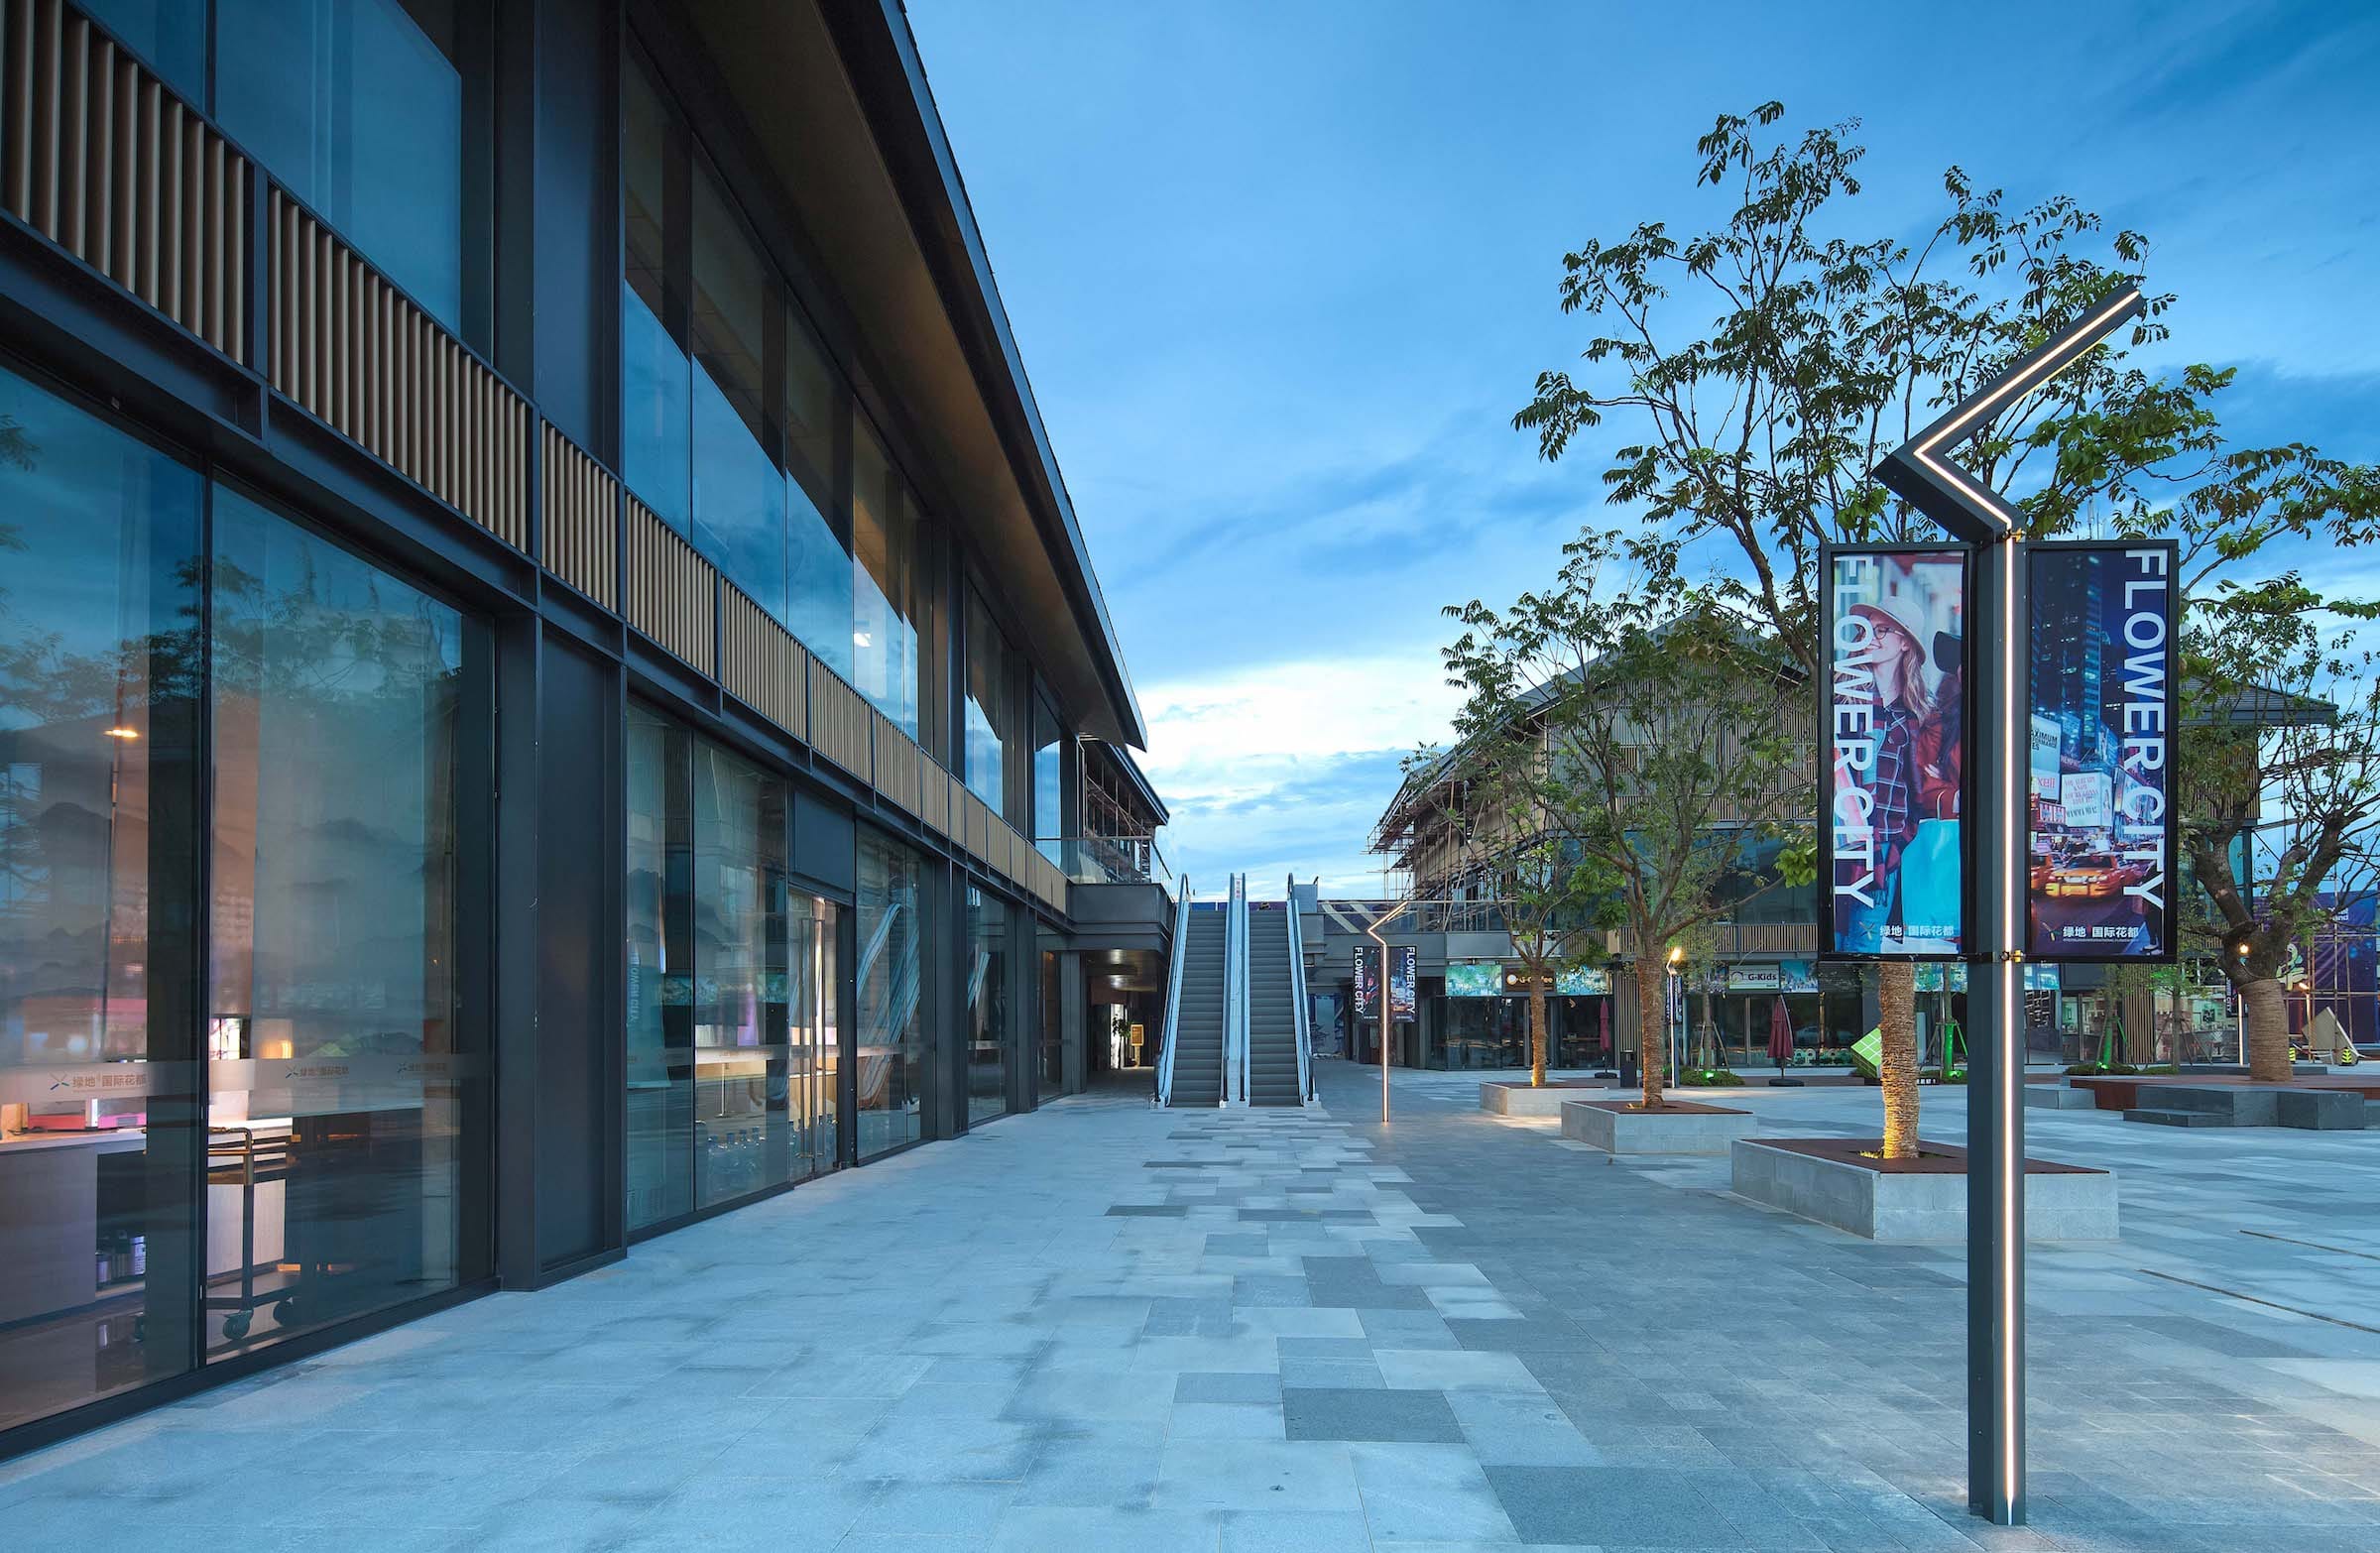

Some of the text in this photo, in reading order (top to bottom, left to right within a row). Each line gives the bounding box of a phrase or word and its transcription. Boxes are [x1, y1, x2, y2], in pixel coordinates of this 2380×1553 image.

[1834, 556, 1874, 908] FLOWER CITY
[2123, 549, 2167, 909] FLOWER CITY
[1880, 924, 1955, 937] 绿地 国际花都
[2063, 925, 2139, 938] 绿地 国际花都
[1355, 947, 1365, 1014] FLOWER CITY
[1406, 947, 1416, 1014] FLOWER CITY
